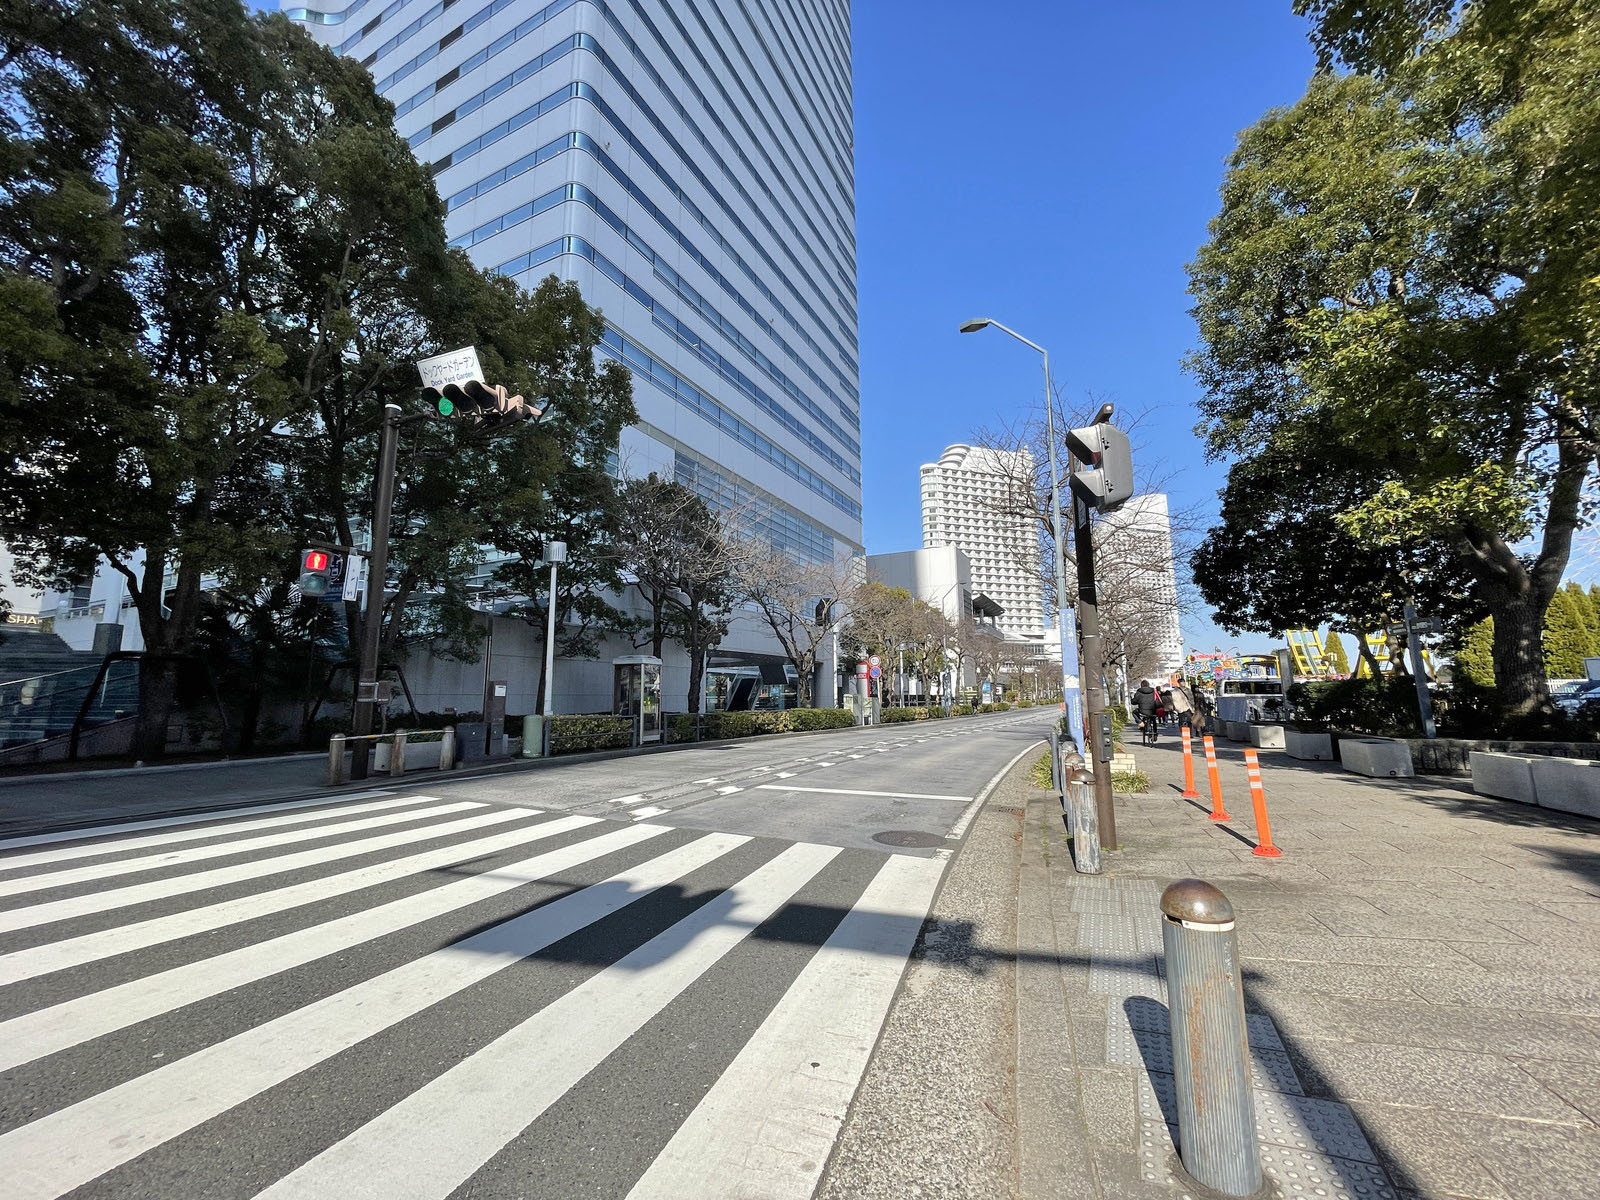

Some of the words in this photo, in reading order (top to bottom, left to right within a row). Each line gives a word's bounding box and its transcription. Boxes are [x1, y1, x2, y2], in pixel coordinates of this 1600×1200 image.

[423, 356, 474, 378] ドックヤードガーデン
[456, 372, 473, 380] Garden
